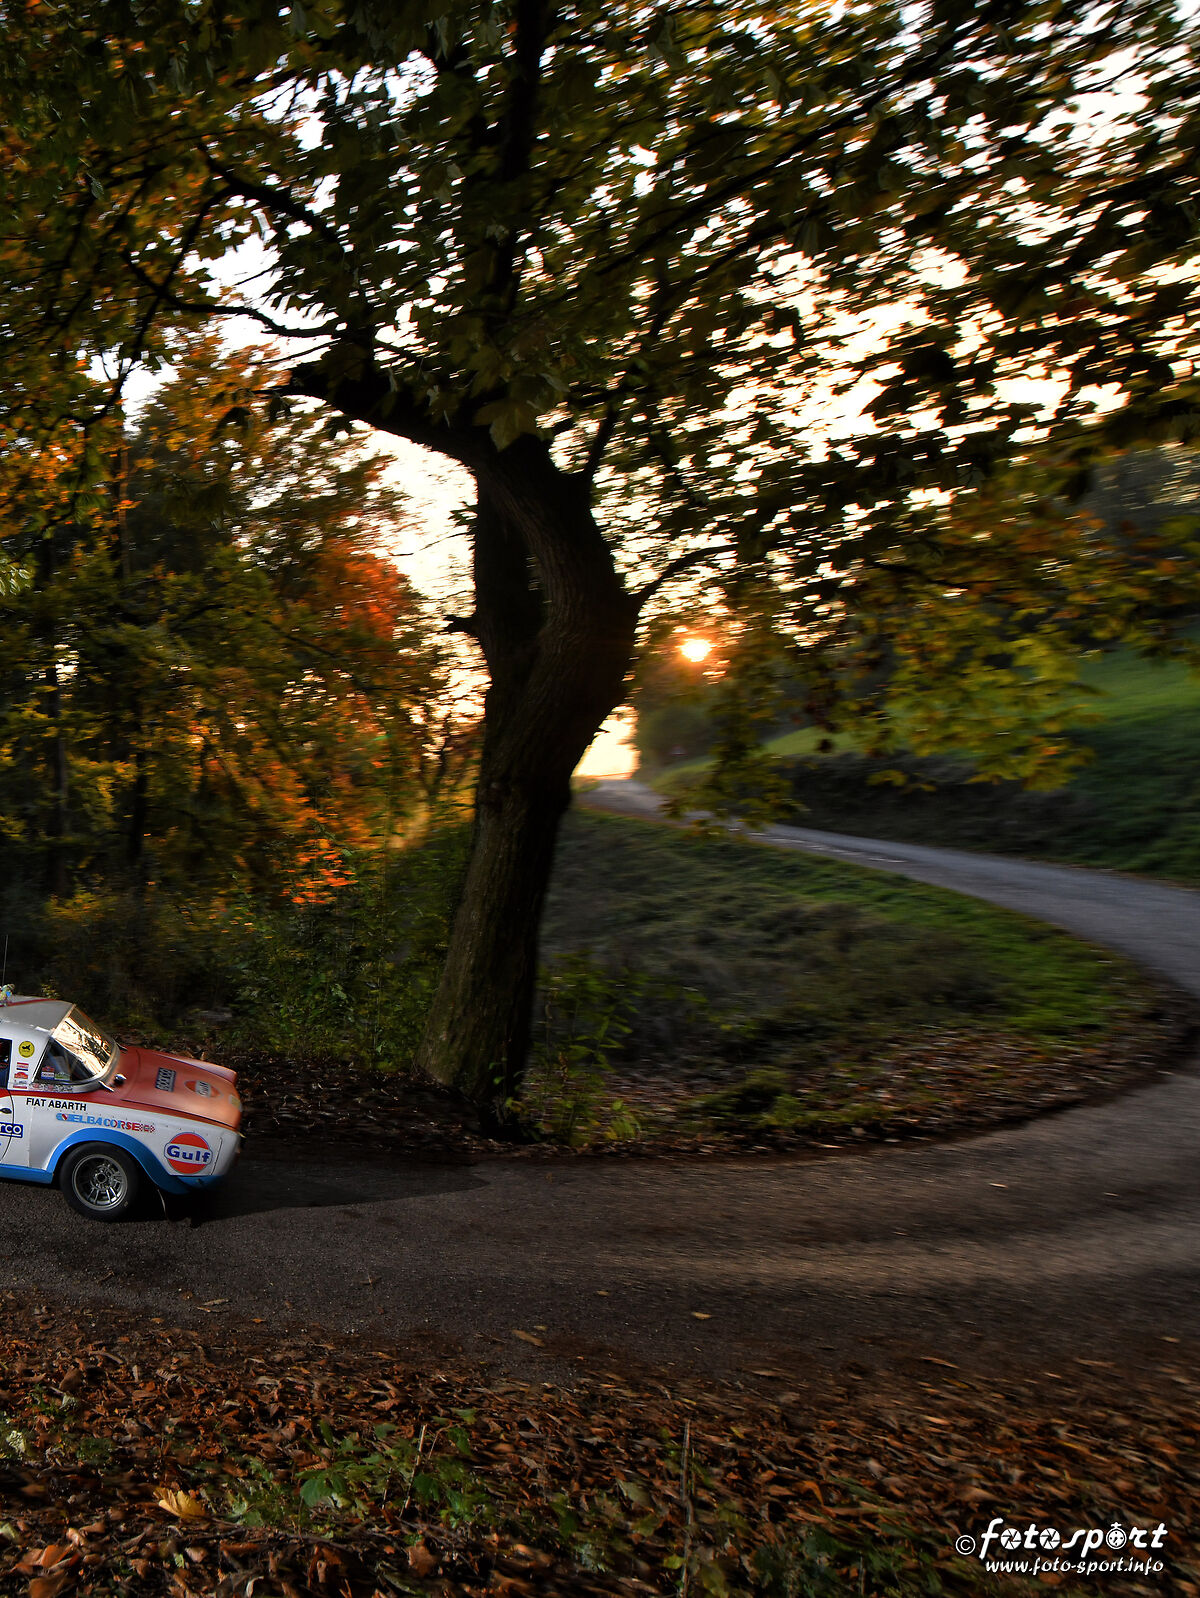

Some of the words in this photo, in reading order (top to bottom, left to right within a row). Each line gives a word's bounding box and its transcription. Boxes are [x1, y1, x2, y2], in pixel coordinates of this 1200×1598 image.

[26, 1097, 47, 1107] FIAT
[48, 1099, 87, 1112] ABARTH
[166, 1144, 211, 1163] Gulf
